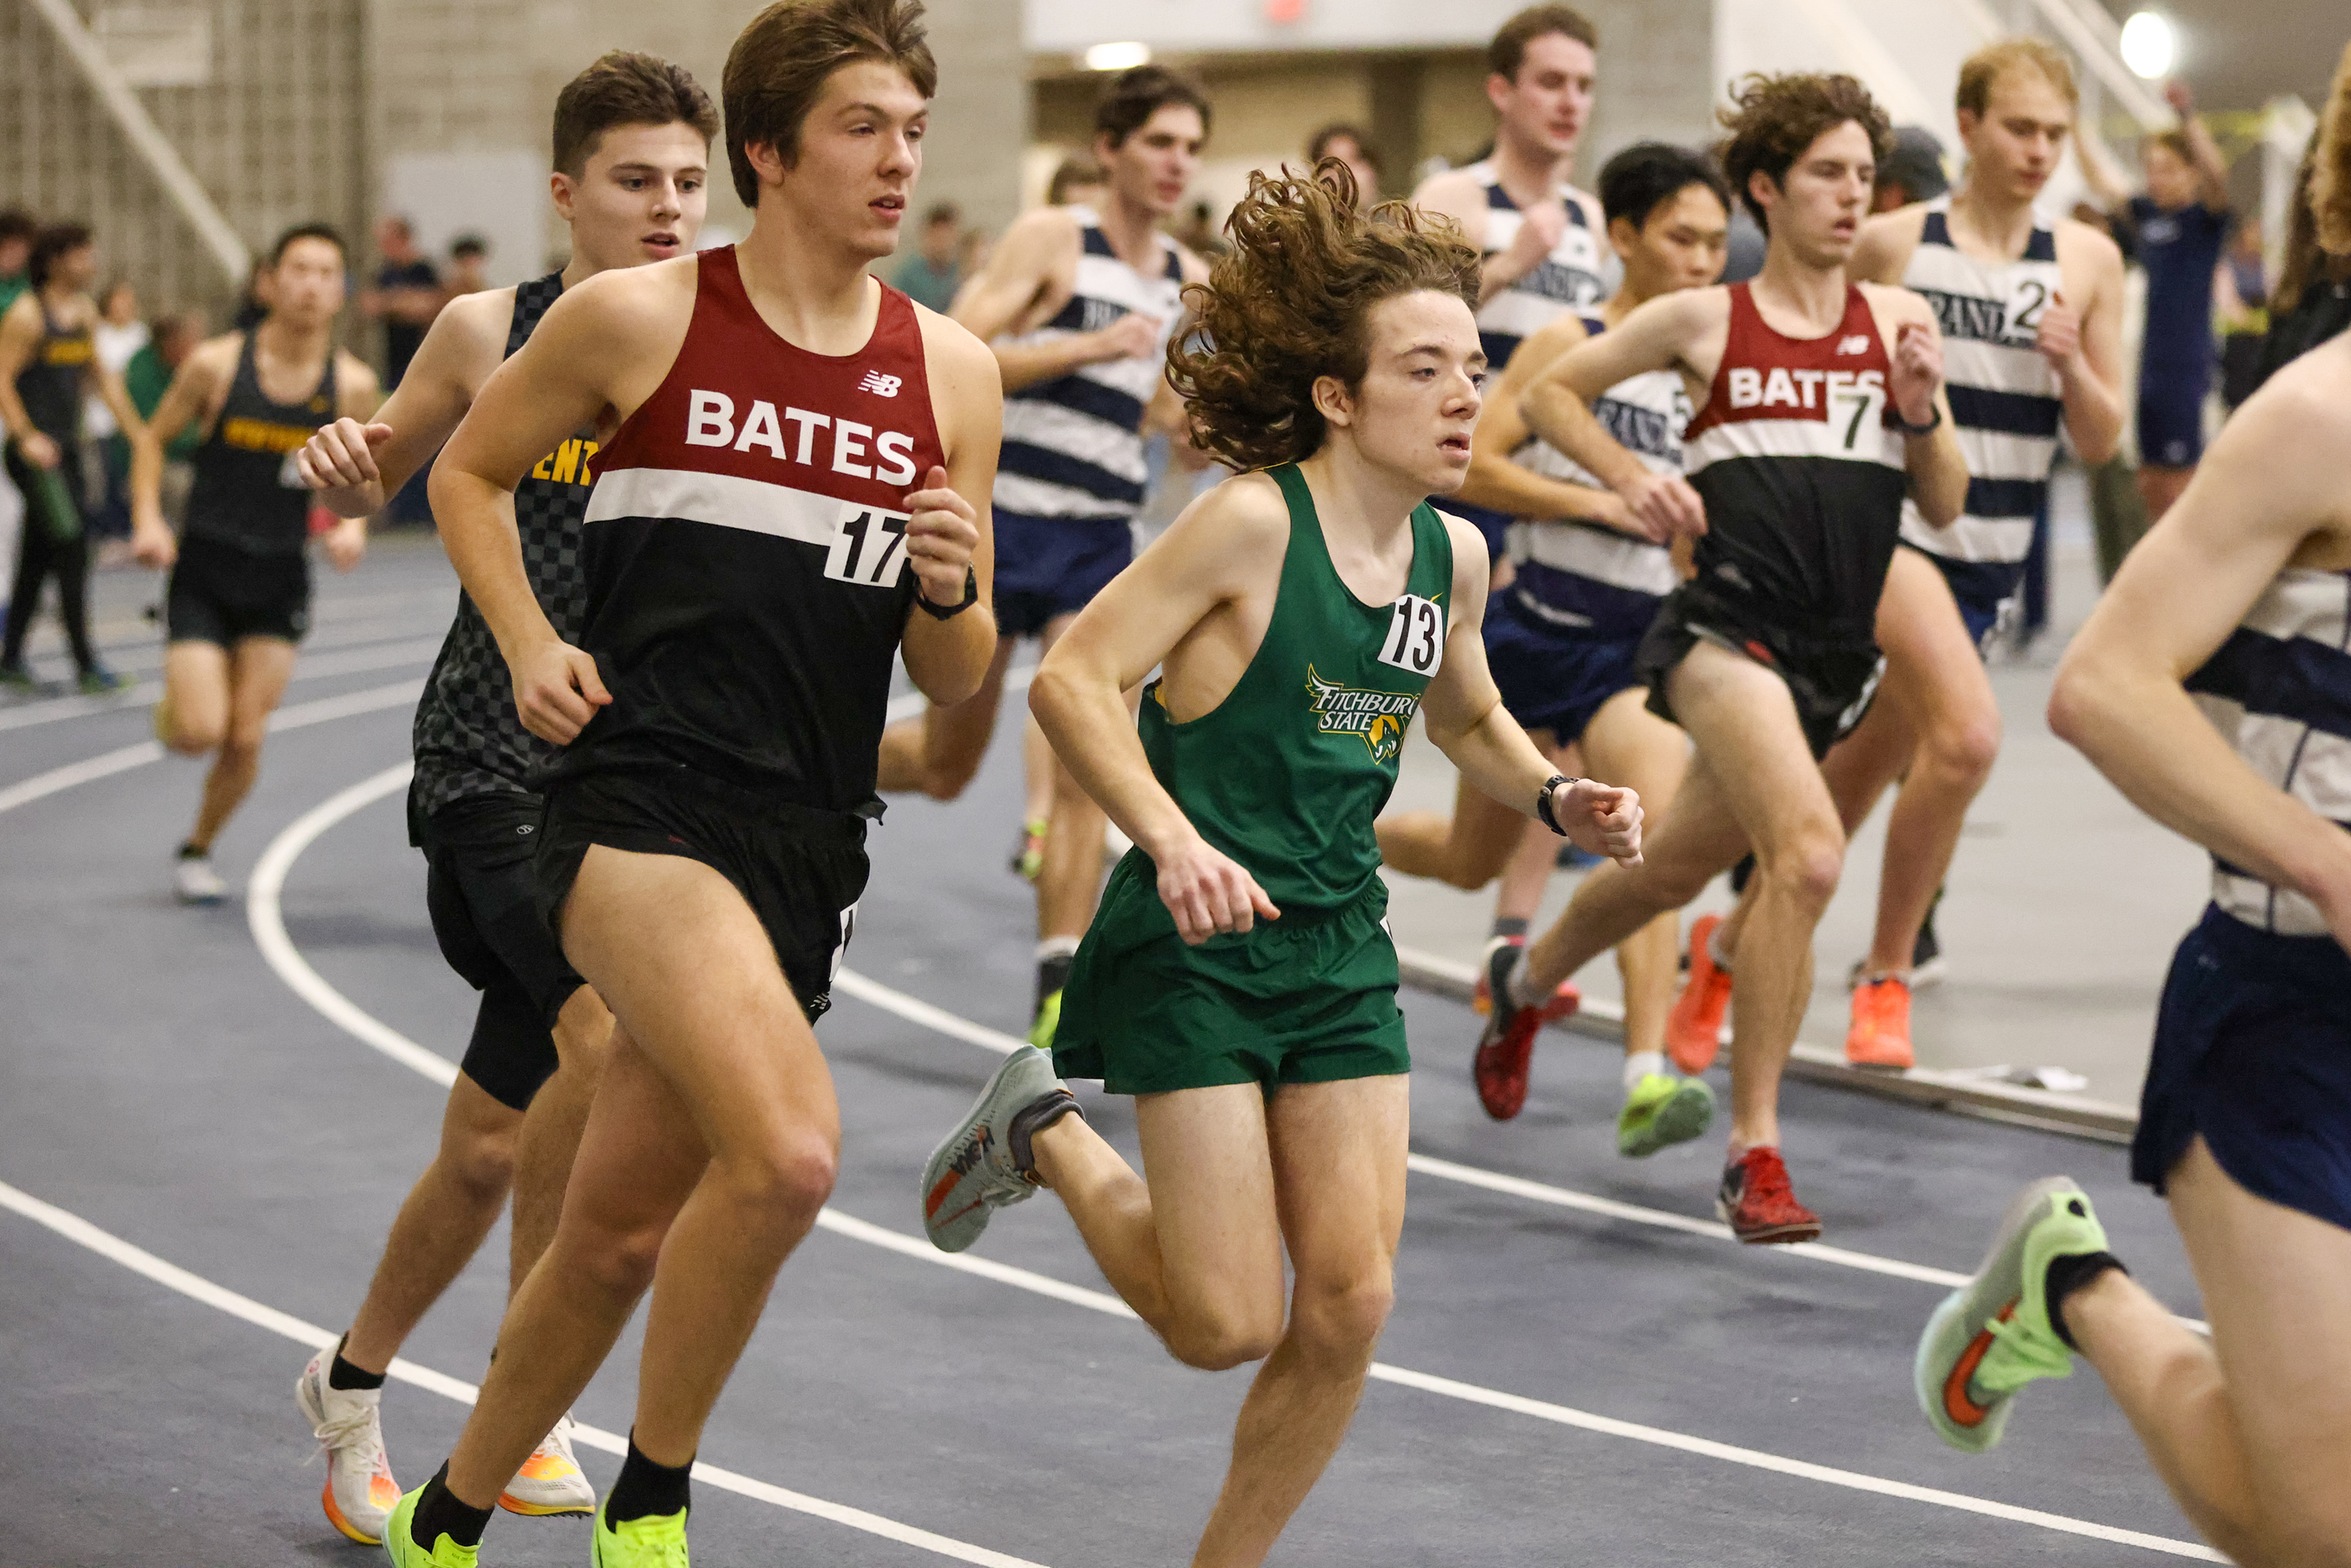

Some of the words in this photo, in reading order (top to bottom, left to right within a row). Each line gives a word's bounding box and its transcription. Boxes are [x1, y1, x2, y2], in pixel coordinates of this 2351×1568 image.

[2014, 279, 2046, 330] 2
[684, 388, 917, 487] BATES
[1835, 394, 1871, 449] 7
[842, 510, 908, 583] 17
[1392, 596, 1436, 671] 13
[1319, 710, 1378, 731] STATE
